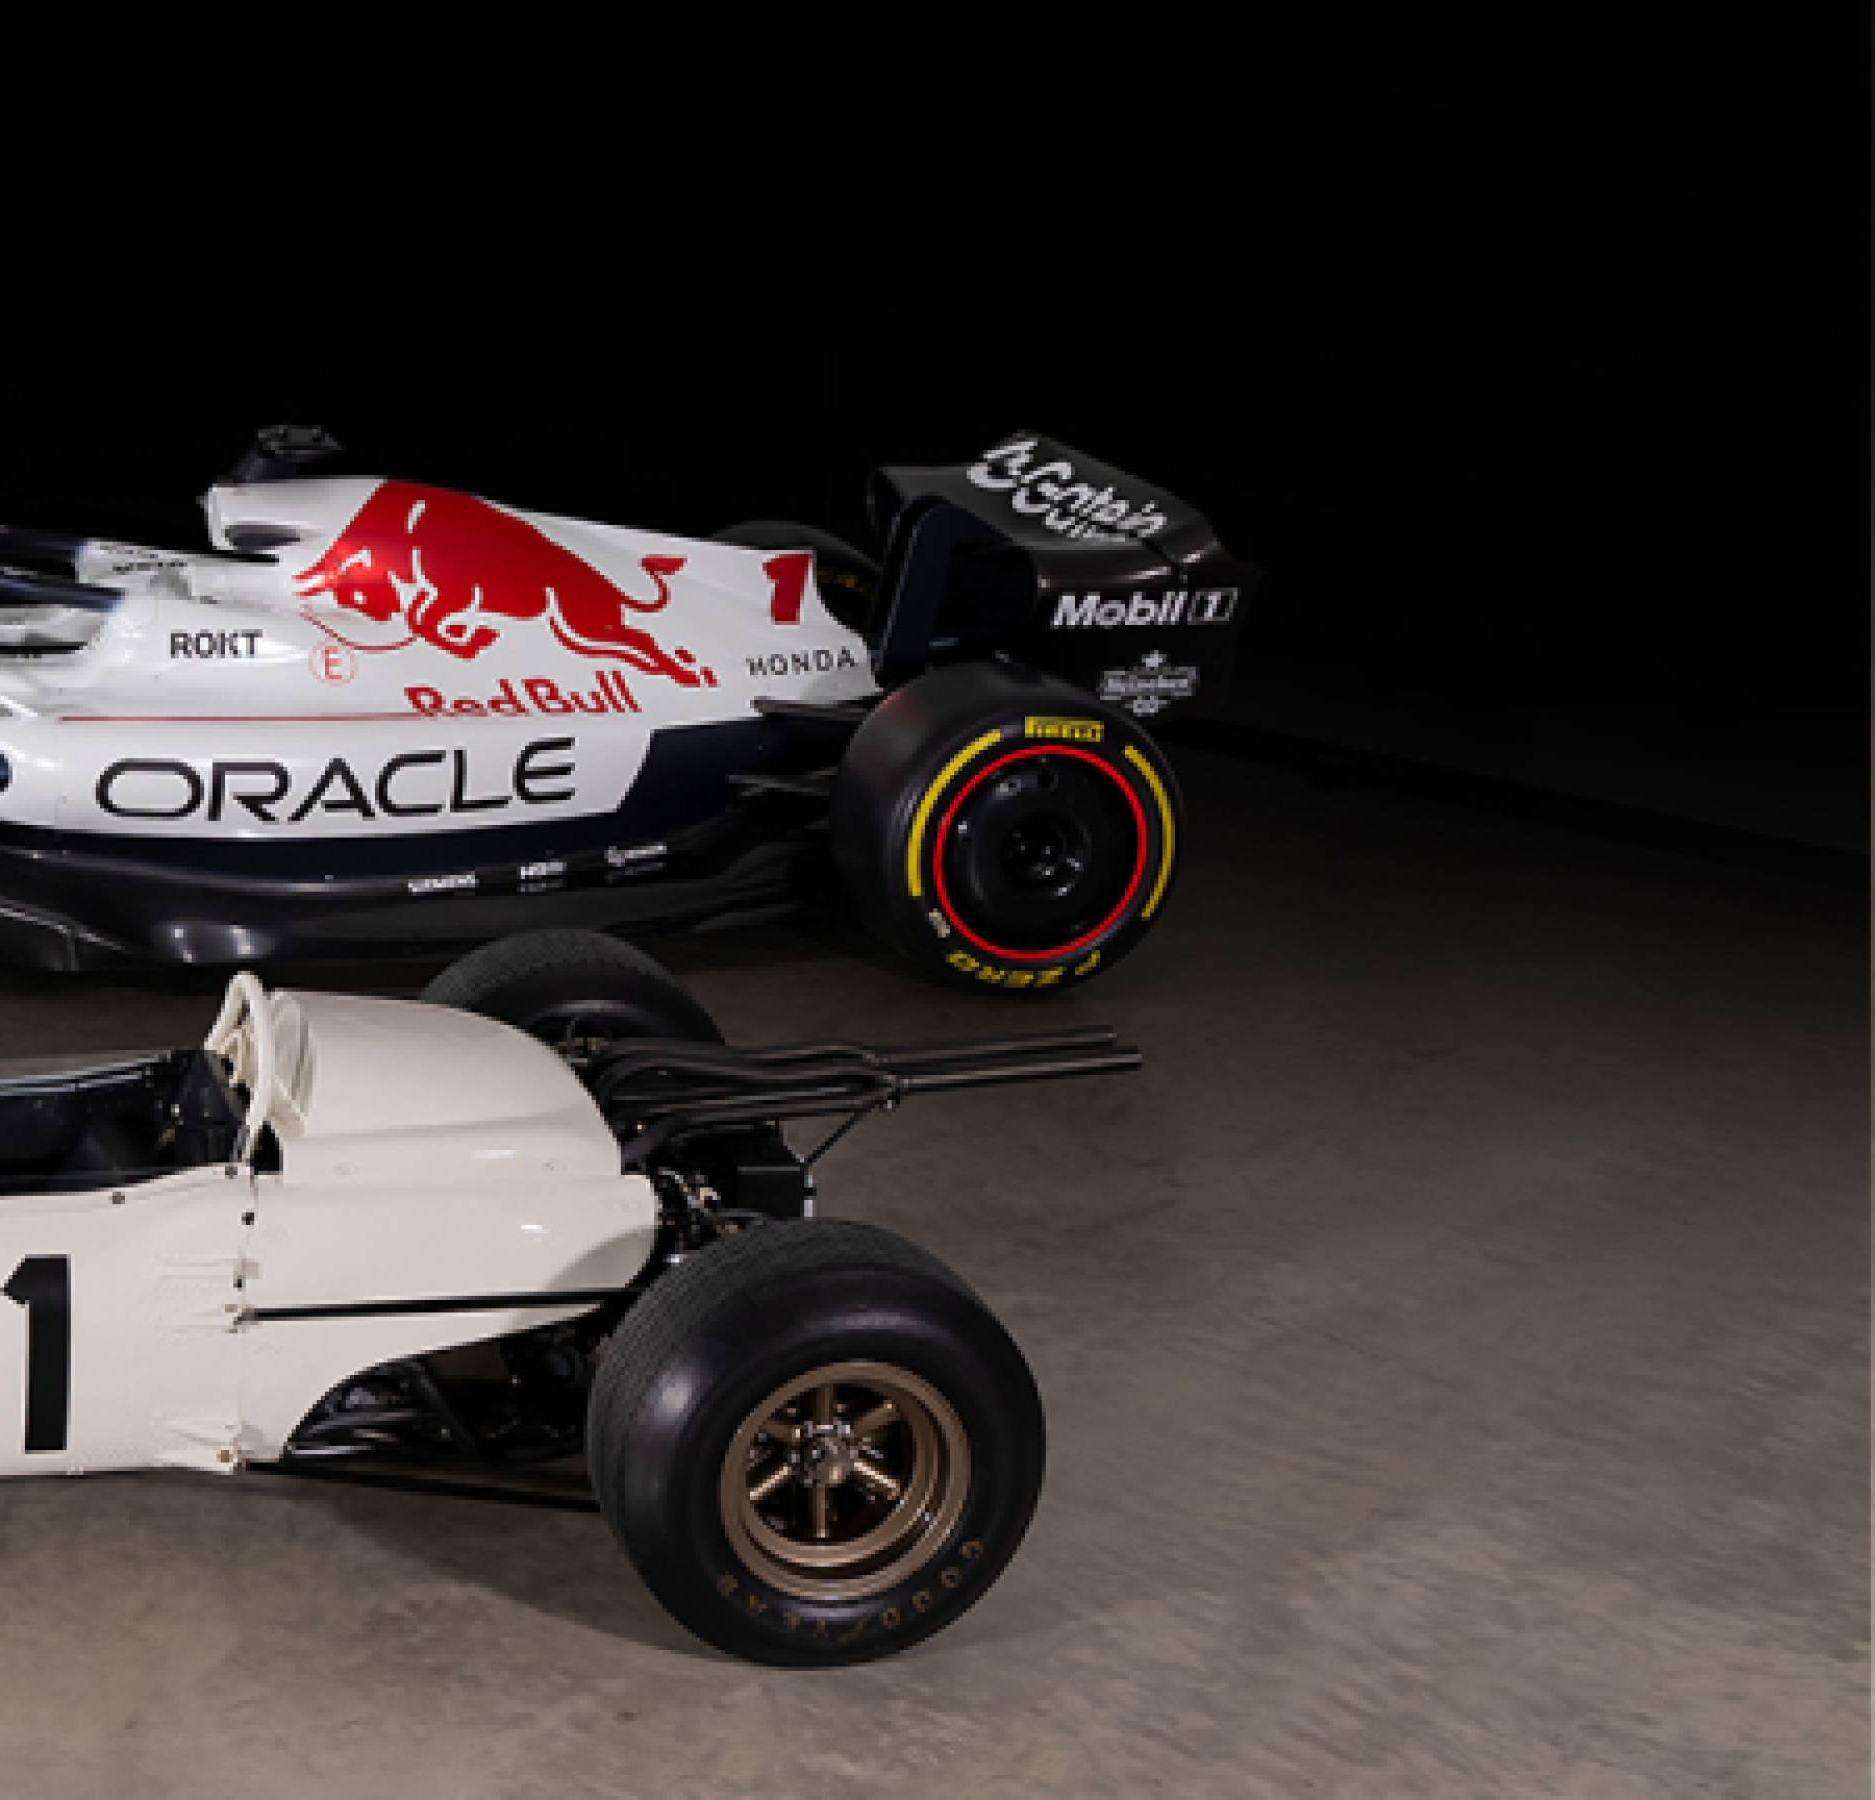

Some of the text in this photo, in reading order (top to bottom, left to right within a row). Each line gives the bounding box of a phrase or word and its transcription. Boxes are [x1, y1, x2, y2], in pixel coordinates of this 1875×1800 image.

[762, 553, 812, 625] 1
[1049, 592, 1187, 628] Mobil
[168, 632, 264, 662] ROKT
[745, 646, 858, 677] HONDA
[403, 670, 643, 717] Red Bull
[95, 737, 576, 825] ORACLE
